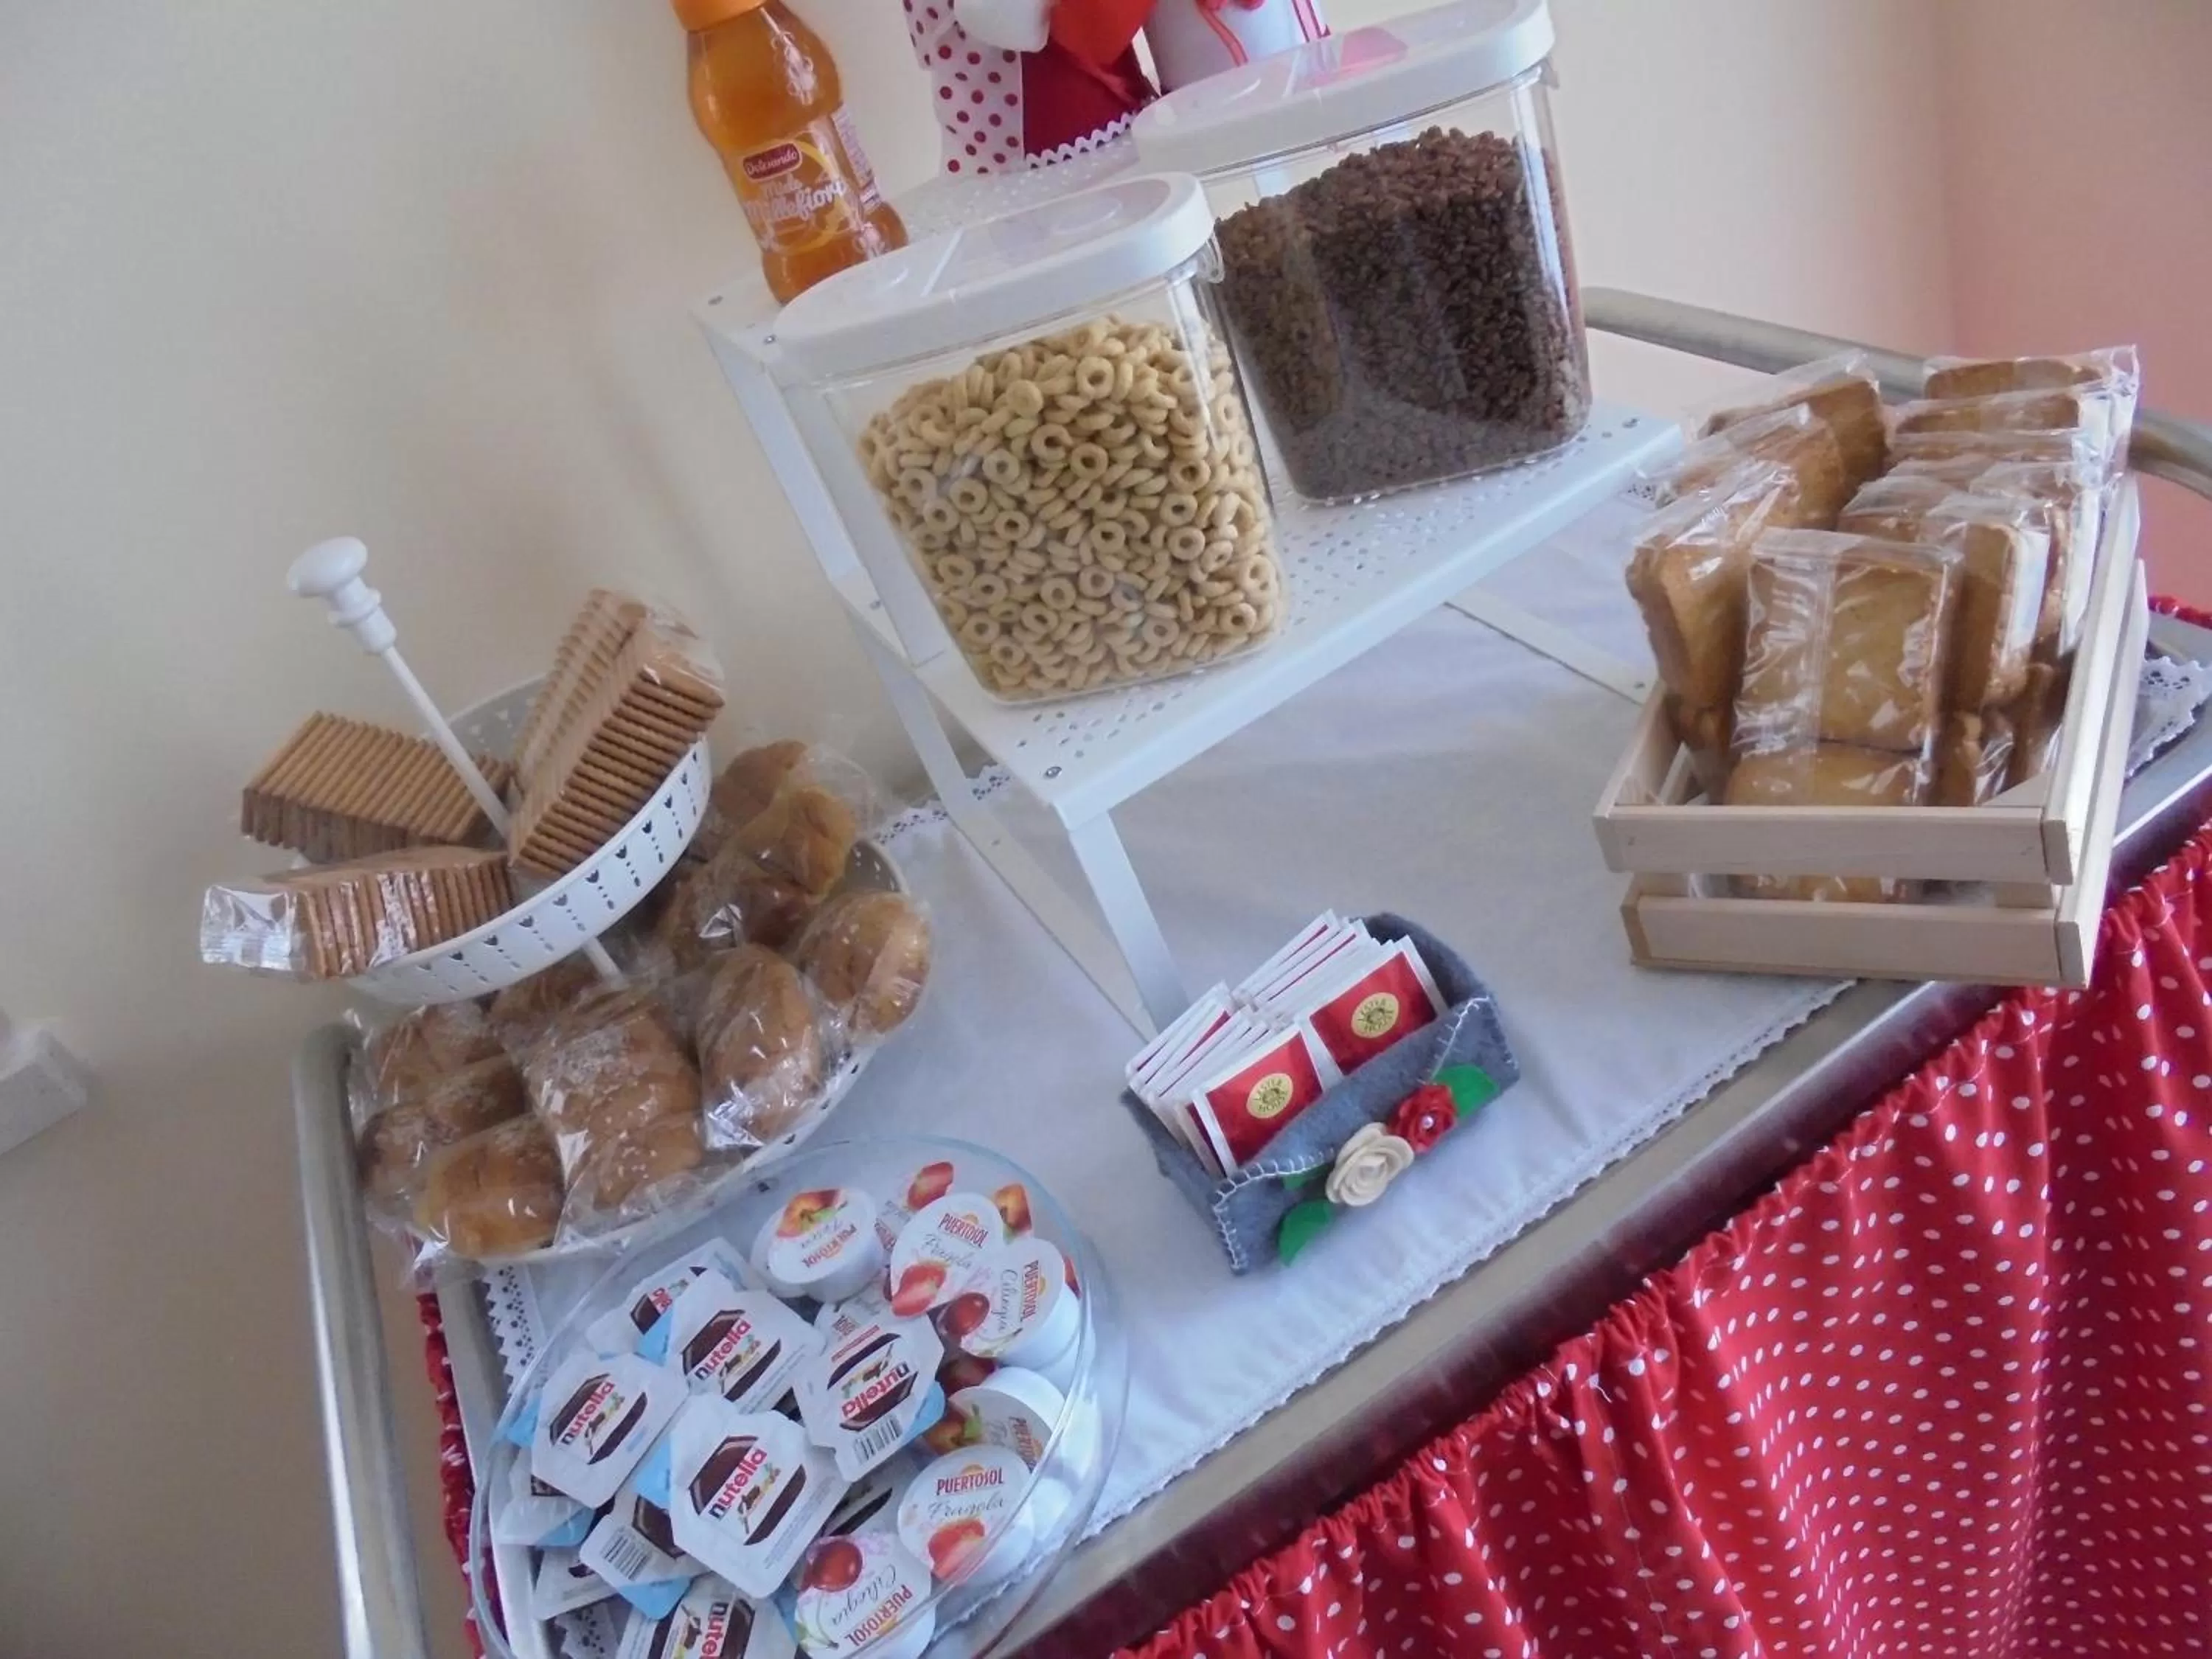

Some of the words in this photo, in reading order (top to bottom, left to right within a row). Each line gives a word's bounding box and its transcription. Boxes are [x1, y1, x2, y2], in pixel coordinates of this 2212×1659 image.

[938, 1213, 989, 1248] PUERTOSOL
[695, 1318, 752, 1381] nutella
[560, 1380, 616, 1446] nutella
[841, 1361, 911, 1417] nutella
[708, 1448, 768, 1521] nutella
[936, 1467, 1005, 1496] PUERTOSOL
[698, 1601, 730, 1659] nutel
[844, 1584, 914, 1646] PUERTOSOL
